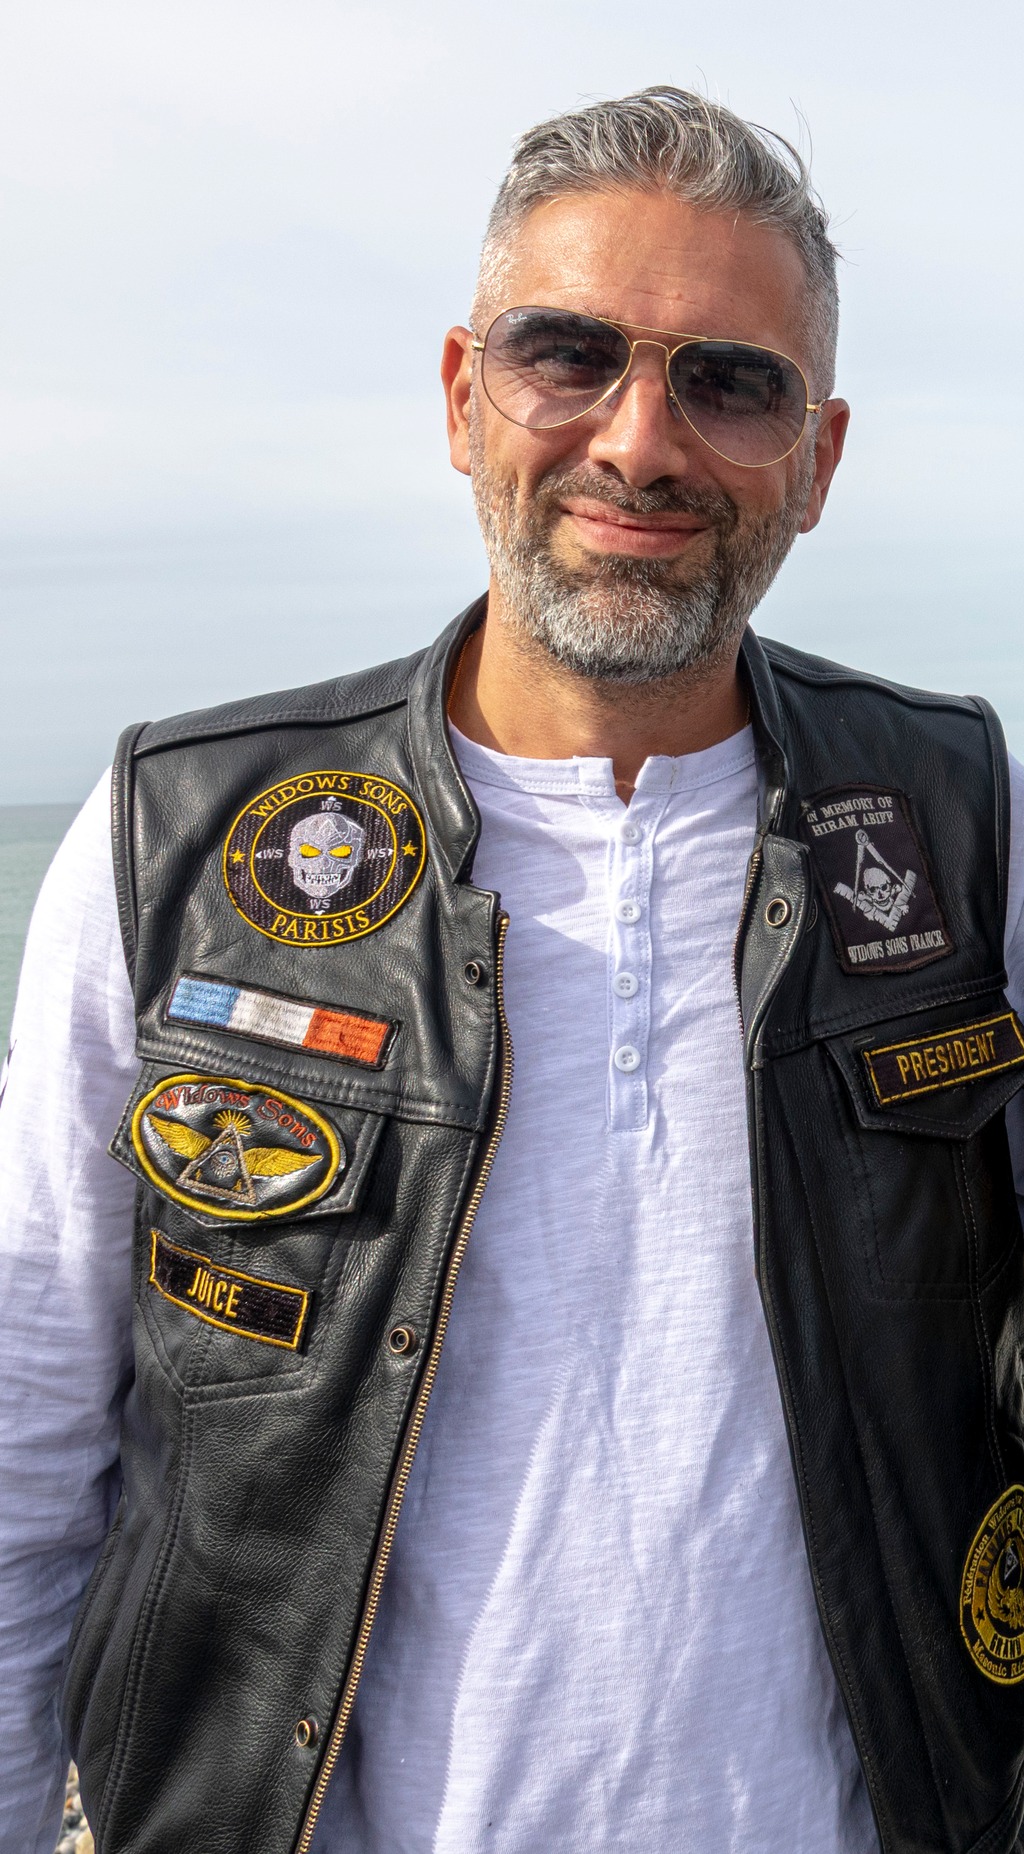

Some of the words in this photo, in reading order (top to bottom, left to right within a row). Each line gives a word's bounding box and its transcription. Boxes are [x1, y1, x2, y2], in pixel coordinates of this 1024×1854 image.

[250, 776, 350, 818] WIDOWS
[359, 781, 409, 815] SONS
[321, 800, 342, 811] WS
[820, 797, 875, 818] MEMORY
[877, 796, 893, 808] OF
[811, 814, 859, 836] HIRAM
[862, 811, 894, 825] ABIFF
[263, 849, 284, 859] WS
[367, 849, 386, 859] WS
[310, 899, 330, 909] WS
[270, 910, 370, 940] PARISIS
[847, 941, 885, 963] WIDOWS
[885, 936, 909, 956] SONS
[909, 930, 946, 951] FRANCE
[896, 1030, 996, 1085] PRESIDENT
[155, 1084, 250, 1111] Widows
[256, 1098, 318, 1148] Sons
